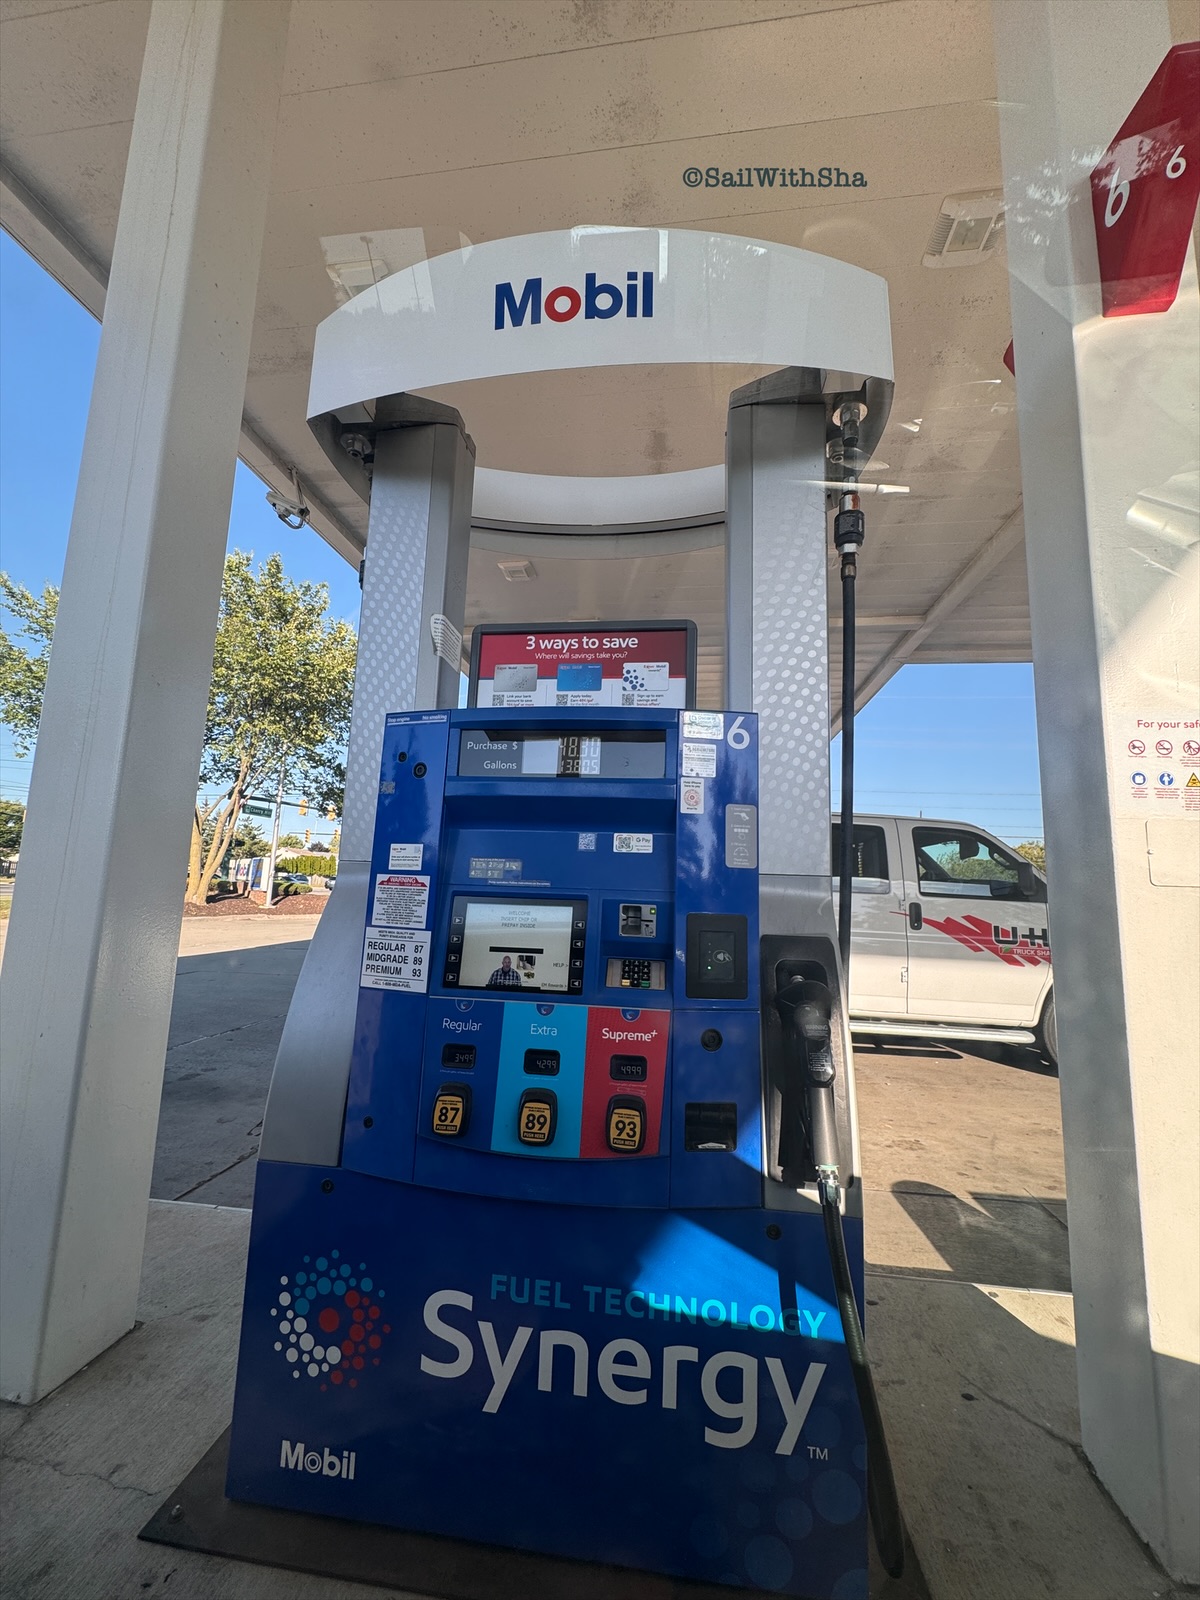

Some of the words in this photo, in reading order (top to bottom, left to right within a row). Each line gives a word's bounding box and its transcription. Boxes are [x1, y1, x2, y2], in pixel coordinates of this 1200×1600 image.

[1166, 144, 1187, 179] 6
[494, 271, 654, 331] Mobil
[526, 636, 536, 650] 3
[539, 638, 578, 653] ways
[582, 636, 599, 648] to
[602, 637, 639, 648] save
[571, 652, 595, 660] savings
[612, 652, 628, 660] you?
[727, 716, 750, 750] 6
[1137, 719, 1154, 728] For
[1156, 721, 1181, 731] your
[1183, 719, 1200, 729] saf
[467, 741, 508, 751] Purchase
[512, 741, 518, 751] $
[483, 760, 517, 770] Gallons
[993, 925, 1049, 947] U-H
[367, 941, 406, 952] REGULAR
[413, 944, 424, 954] 87
[1013, 948, 1036, 956] TRUCK
[366, 952, 409, 965] MIDGRADE
[412, 956, 423, 966] 89
[365, 964, 402, 976] PREMIUM
[412, 968, 422, 978] 93
[442, 1018, 482, 1034] Regular
[530, 1023, 558, 1037] Extra
[438, 1106, 460, 1124] 87
[525, 1113, 548, 1131] 89
[615, 1119, 637, 1138] 93
[490, 1273, 571, 1309] FUEL
[583, 1285, 827, 1339] TECHNOLOGY
[420, 1288, 828, 1456] Synergy
[279, 1439, 356, 1480] Mobil
